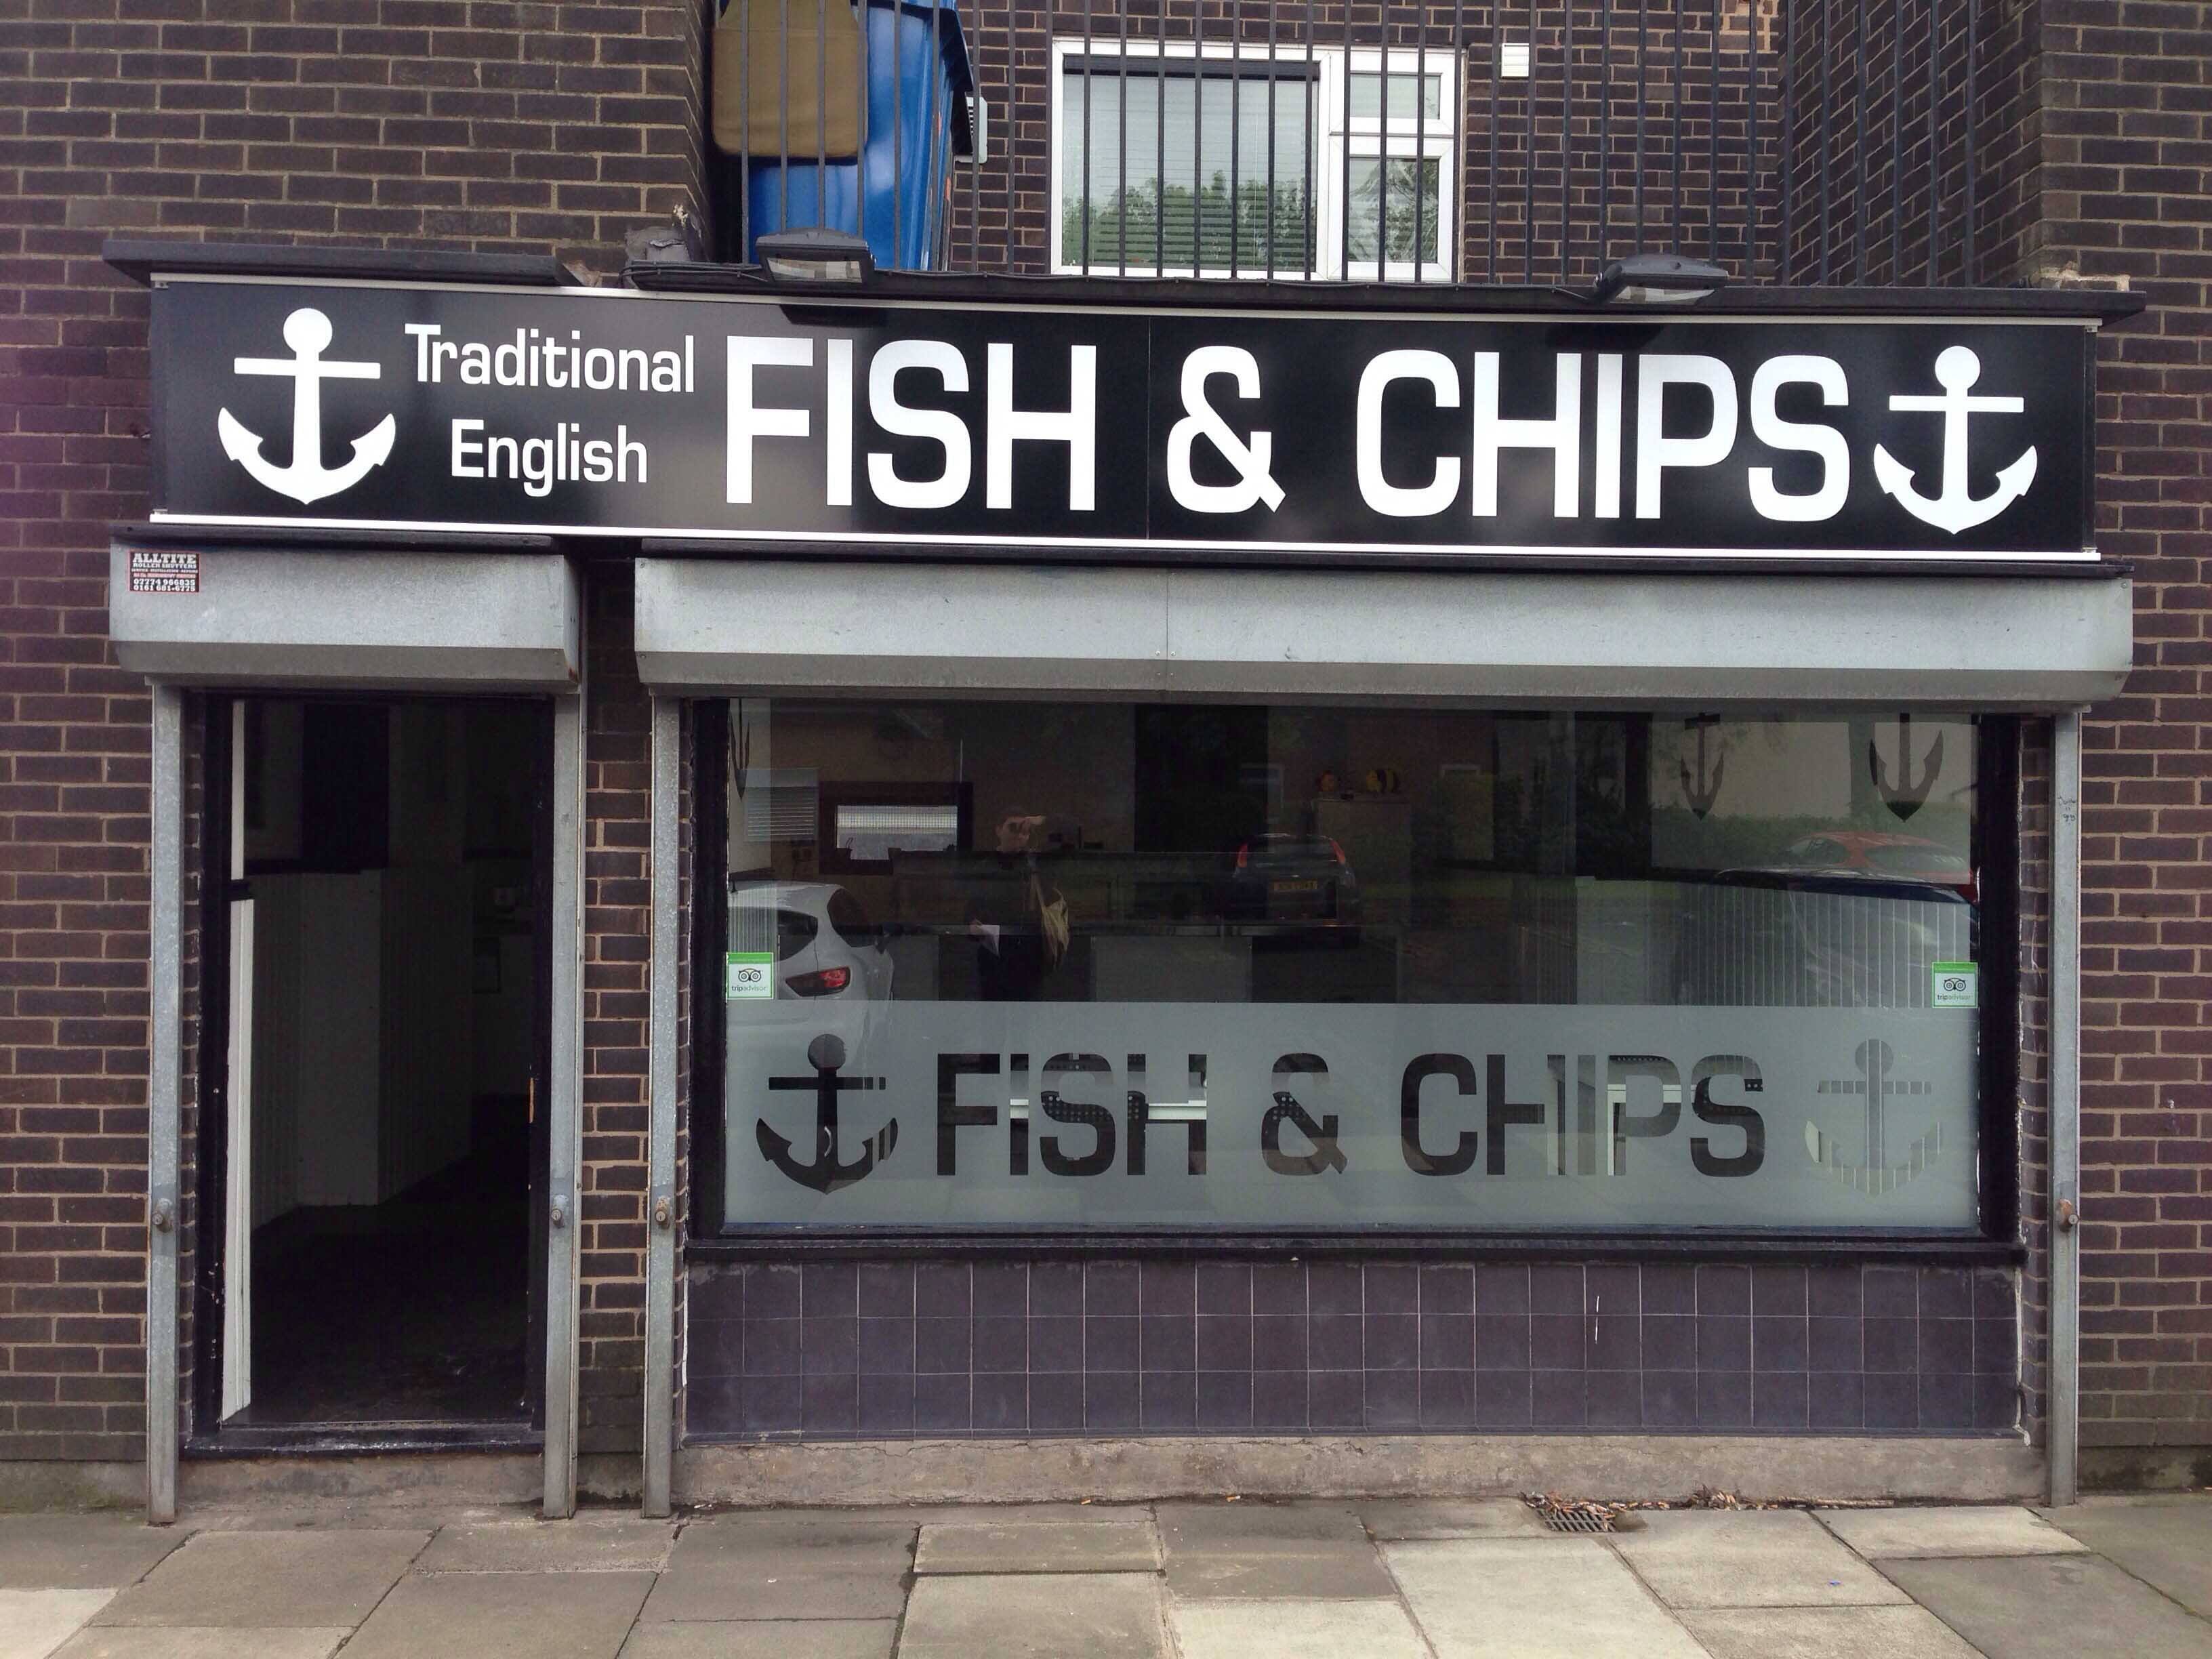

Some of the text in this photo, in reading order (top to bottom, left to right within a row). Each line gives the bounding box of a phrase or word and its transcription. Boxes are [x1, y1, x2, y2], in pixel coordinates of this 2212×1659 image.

[405, 323, 694, 393] Traditional
[451, 418, 648, 497] English
[726, 335, 1851, 522] FISH & CHIPS
[133, 553, 197, 563] ALLTITE
[937, 1052, 1766, 1177] FISH & CHIPS
